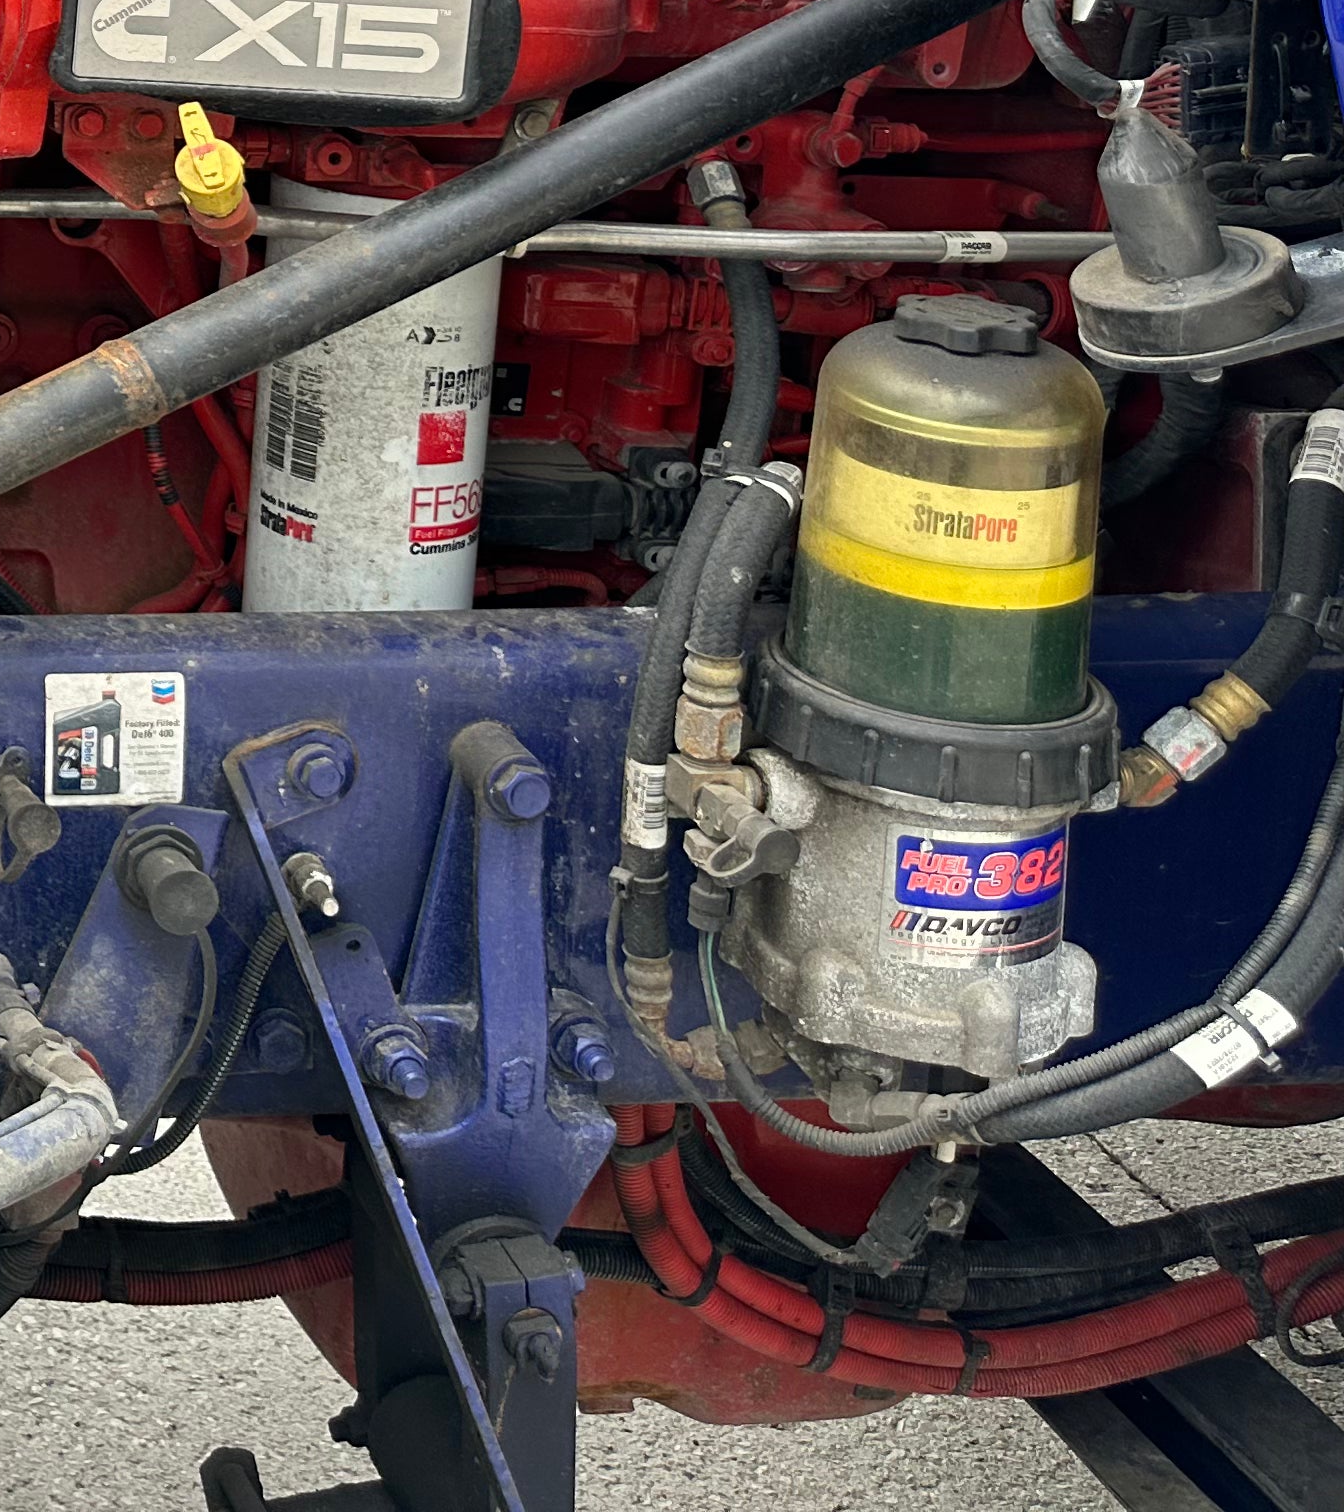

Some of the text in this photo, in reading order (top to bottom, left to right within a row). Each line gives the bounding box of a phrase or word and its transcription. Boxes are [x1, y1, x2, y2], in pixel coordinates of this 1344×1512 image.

[410, 476, 482, 523] FF56
[1017, 501, 1030, 511] 25
[287, 502, 318, 520] Mexico
[913, 504, 1017, 542] StrataPore
[415, 530, 436, 539] Fuel
[409, 540, 465, 555] Cummins
[900, 849, 972, 877] FUEL
[973, 839, 1065, 900] 382
[906, 870, 969, 896] PRO
[890, 928, 976, 947] Technology
